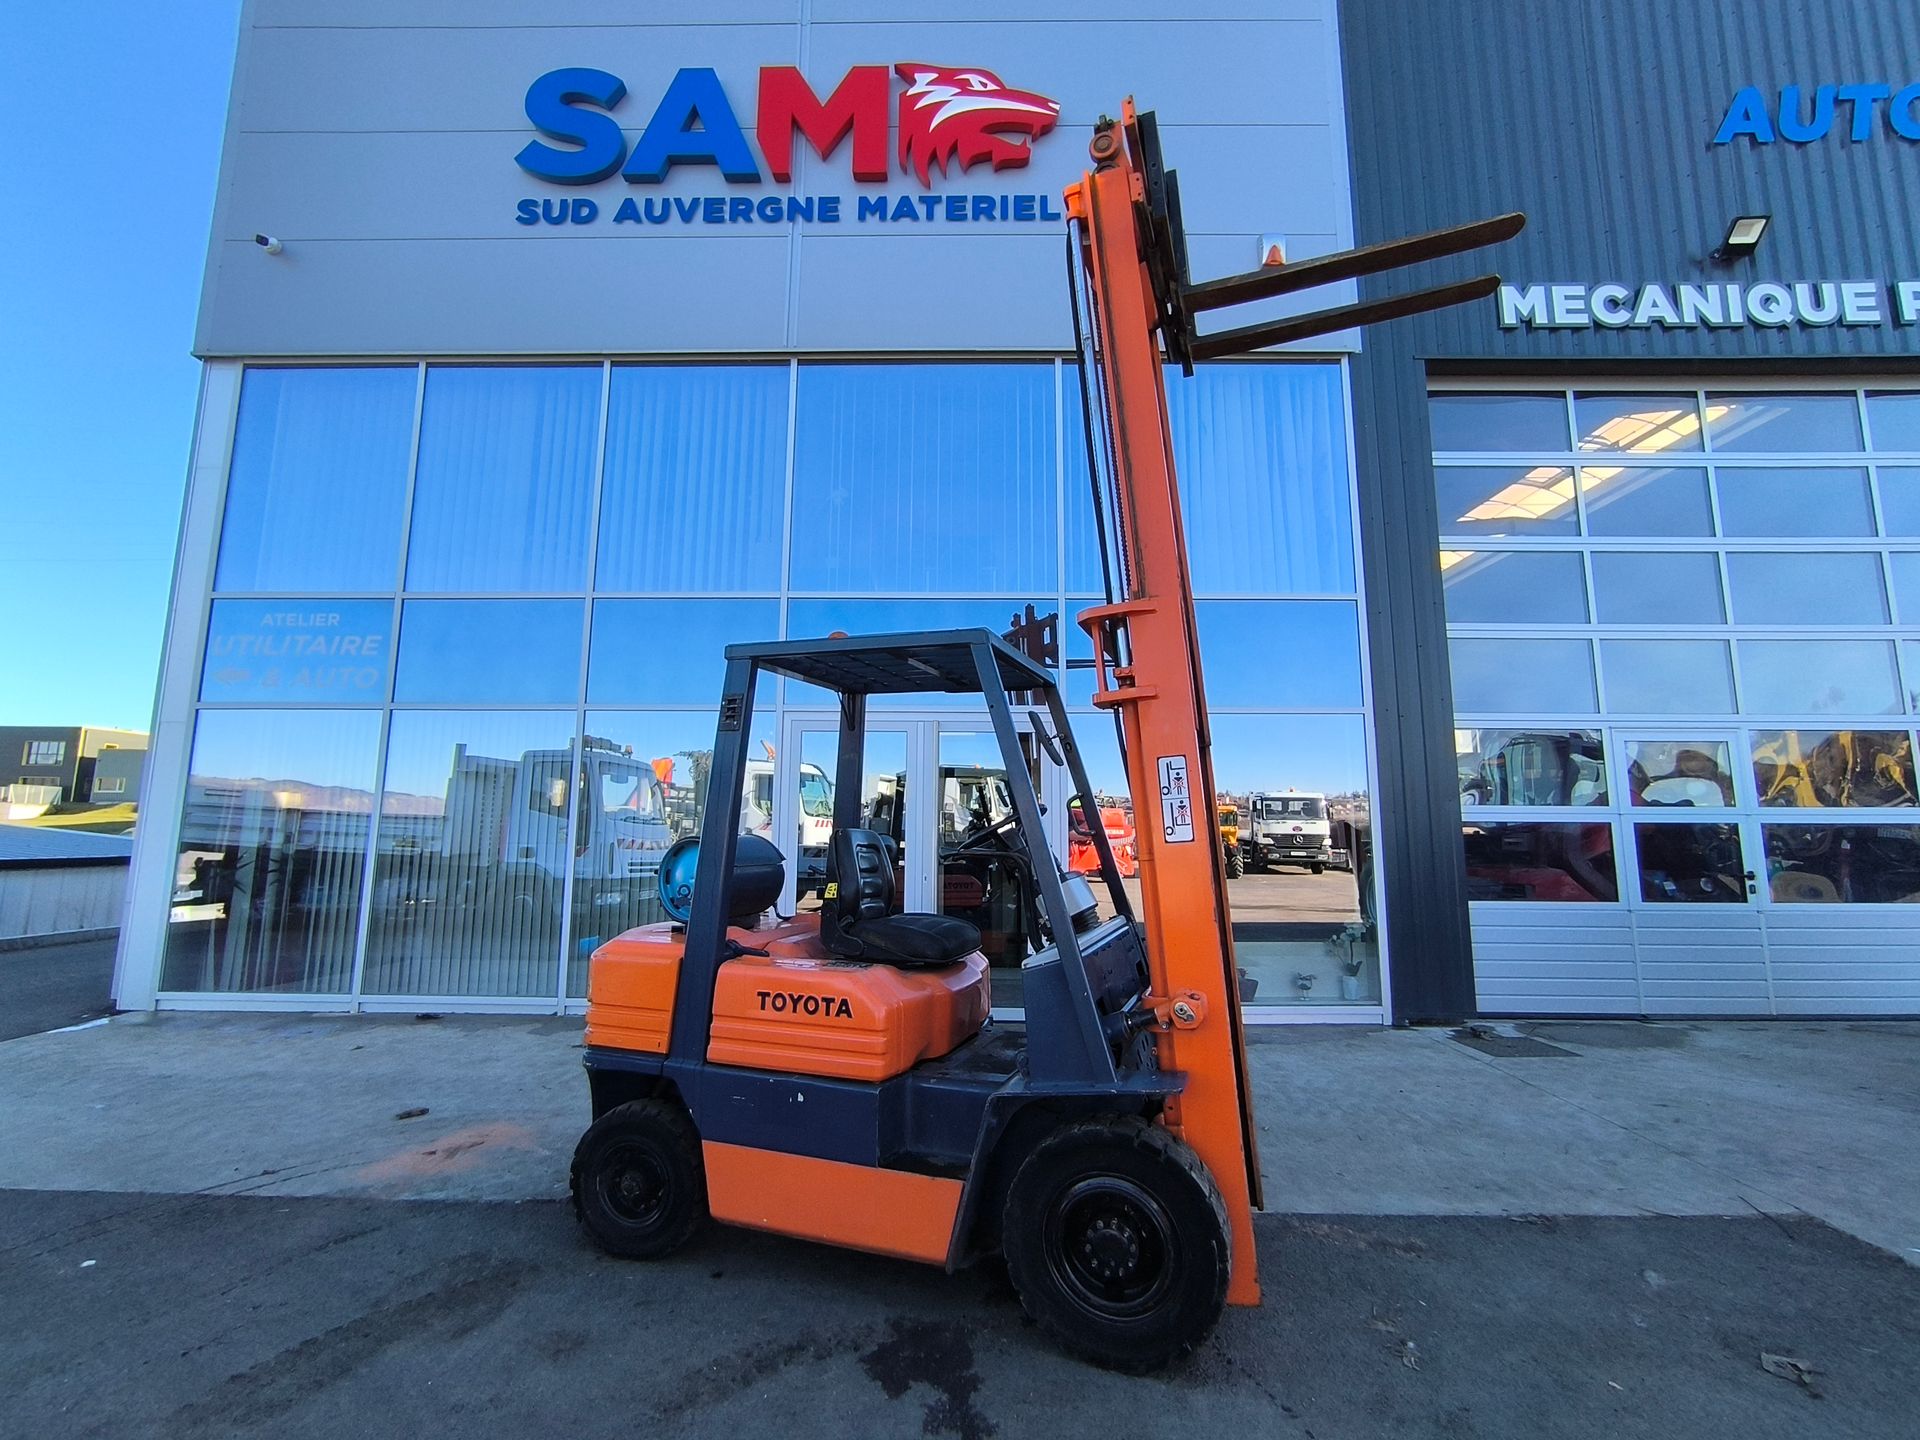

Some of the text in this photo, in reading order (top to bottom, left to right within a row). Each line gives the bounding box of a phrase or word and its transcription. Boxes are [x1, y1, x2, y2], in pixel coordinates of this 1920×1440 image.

[514, 66, 890, 184] SAM
[515, 193, 1062, 226] SUD AUVERGNE MATERIEL
[1499, 281, 1881, 327] MECANIQUE
[260, 612, 340, 627] ATELIER
[211, 634, 383, 657] UTILITAIRE
[260, 666, 378, 689] & AUTO
[756, 990, 853, 1019] TOYOTA
